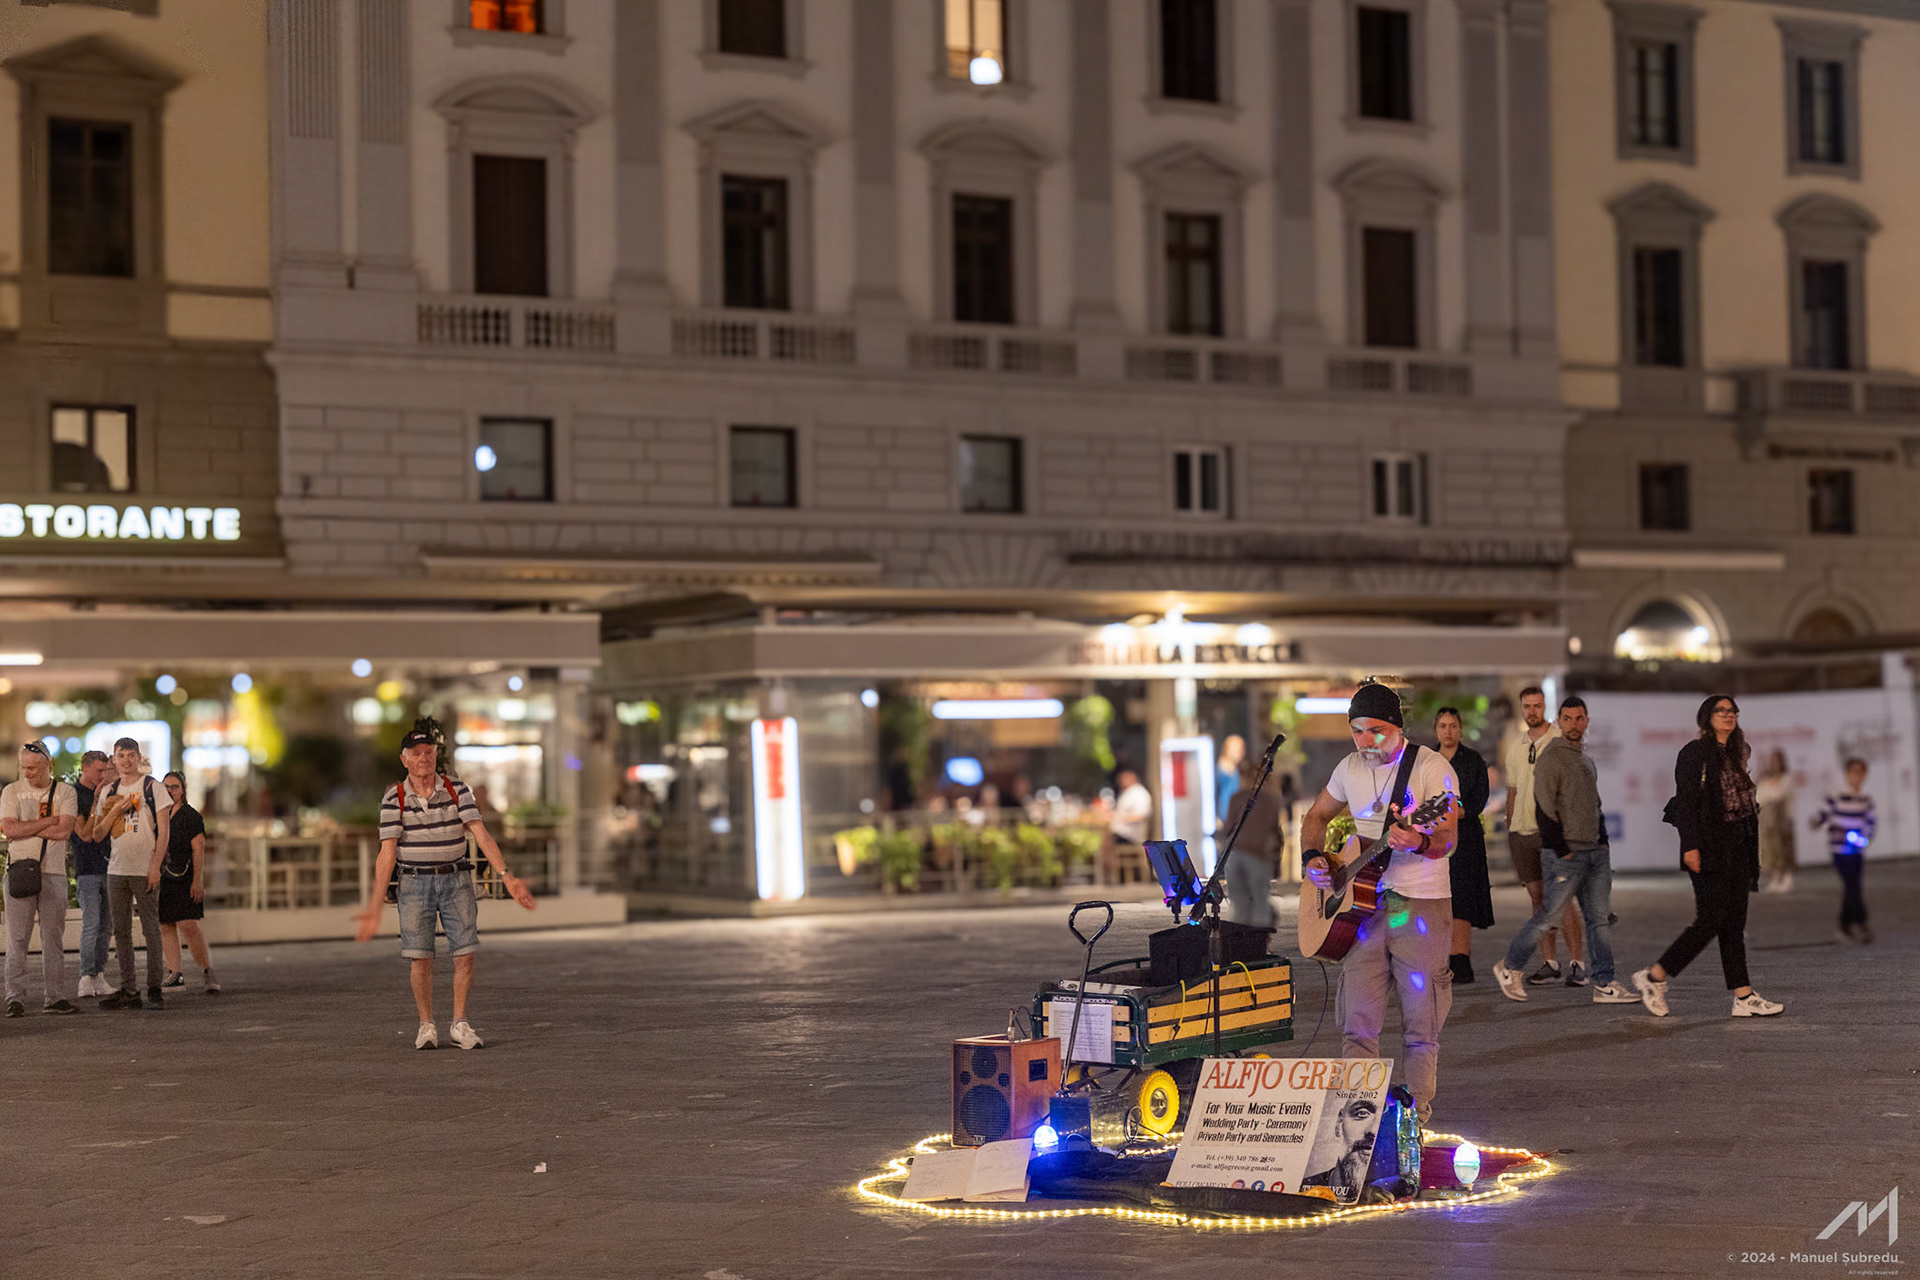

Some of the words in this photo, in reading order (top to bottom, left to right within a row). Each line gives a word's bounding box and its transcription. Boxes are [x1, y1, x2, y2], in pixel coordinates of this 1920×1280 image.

[1202, 1060, 1284, 1098] ALFJO
[1288, 1060, 1386, 1091] GRECO
[1335, 1091, 1357, 1099] Since
[1358, 1091, 1378, 1099] 2002
[1205, 1102, 1221, 1114] For
[1224, 1102, 1245, 1114] Your
[1247, 1102, 1276, 1115] Music
[1278, 1102, 1312, 1116] Events
[1202, 1118, 1236, 1131] Wedding
[1236, 1118, 1260, 1131] Party
[1265, 1118, 1308, 1132] Ceremony
[1197, 1131, 1225, 1141] Private
[1225, 1132, 1247, 1145] Party
[1246, 1132, 1263, 1143] and
